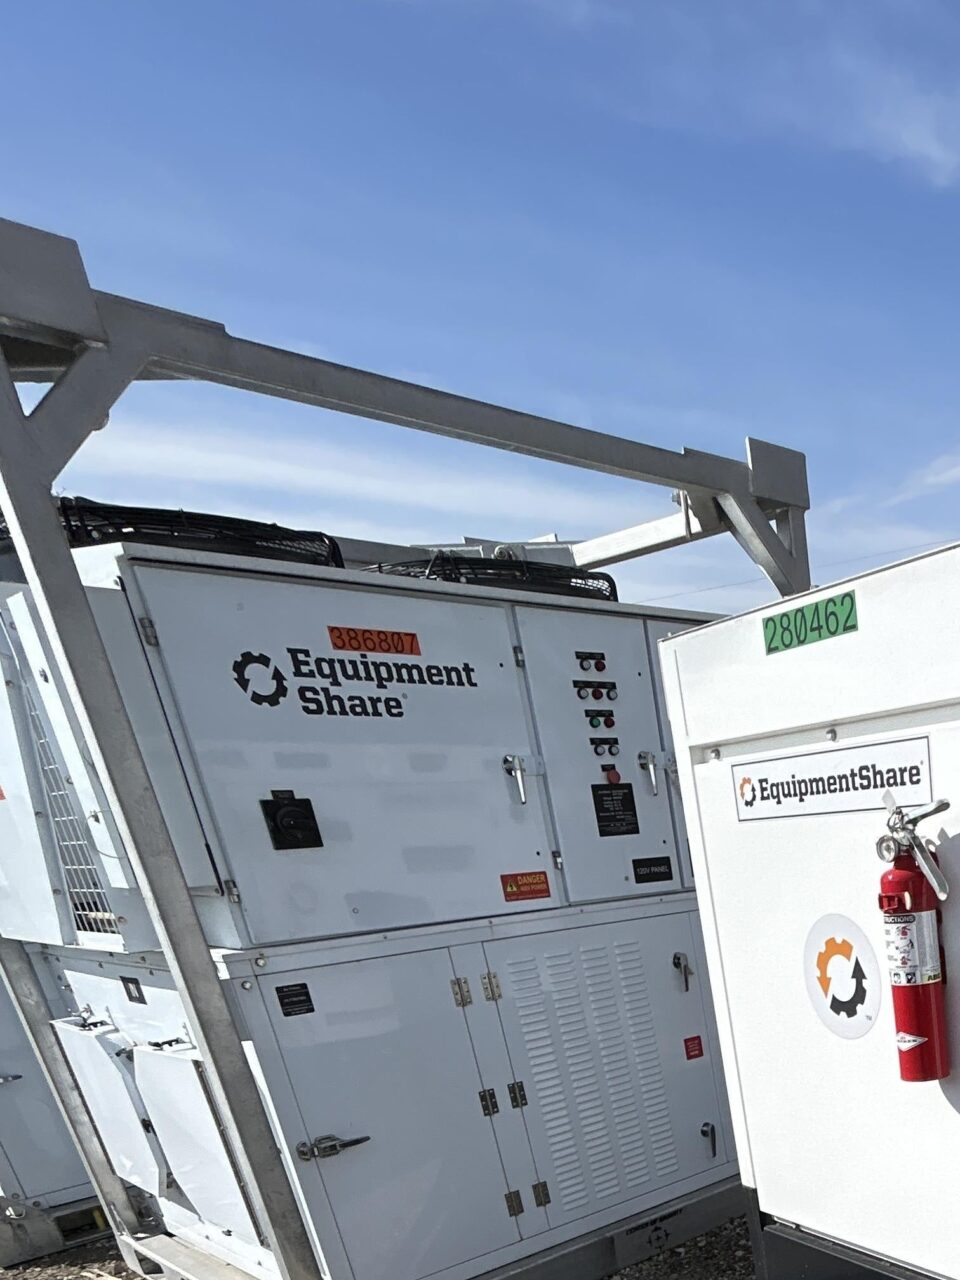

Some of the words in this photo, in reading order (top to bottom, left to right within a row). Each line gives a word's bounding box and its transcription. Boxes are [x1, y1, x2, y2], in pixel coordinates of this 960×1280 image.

[330, 626, 416, 653] 386807
[764, 592, 858, 653] 280462
[286, 648, 478, 689] Equipment
[298, 686, 404, 717] Share
[758, 763, 922, 804] EquipmentShare
[518, 874, 546, 885] DANGER
